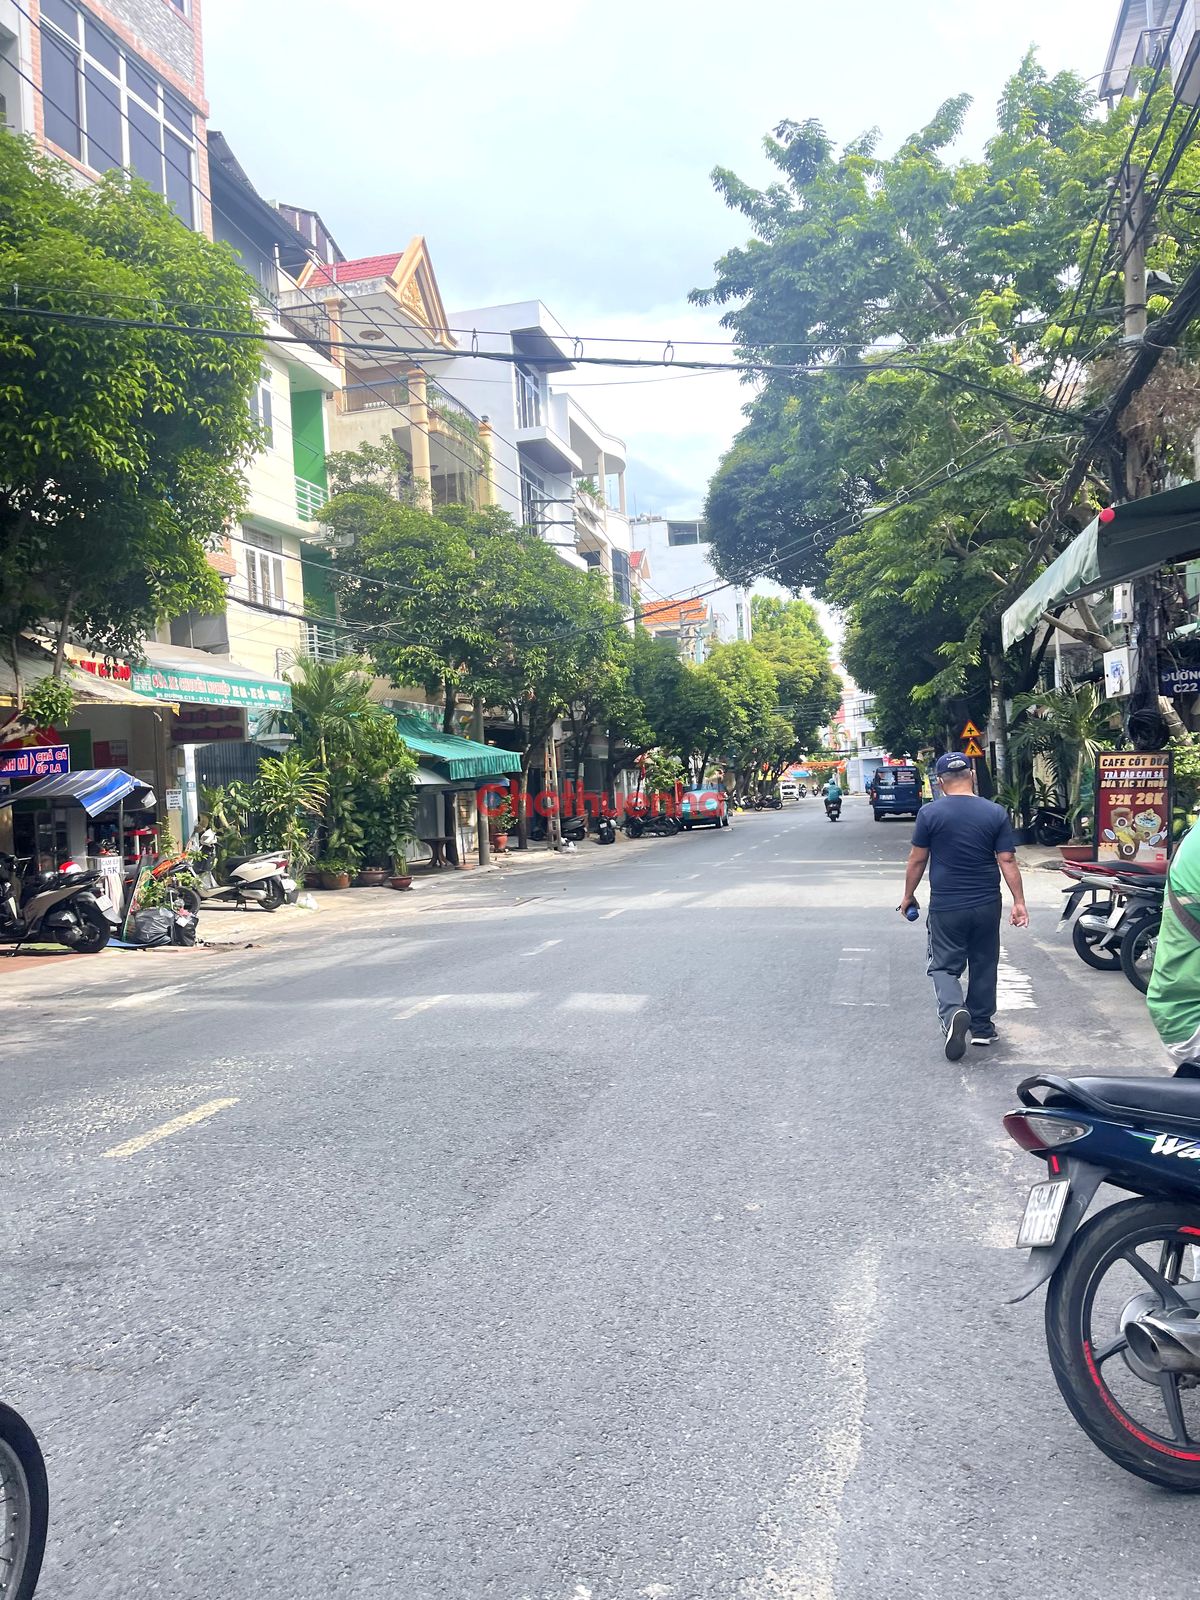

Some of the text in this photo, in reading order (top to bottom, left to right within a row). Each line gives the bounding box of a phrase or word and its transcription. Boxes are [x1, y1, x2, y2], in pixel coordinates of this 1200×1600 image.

[1173, 682, 1199, 694] C22
[36, 748, 67, 761] CHẢ CÁ
[1102, 758, 1126, 767] CAFE
[1128, 756, 1148, 767] CỐT
[50, 763, 61, 773] LA
[1108, 792, 1165, 806] 32K 28K
